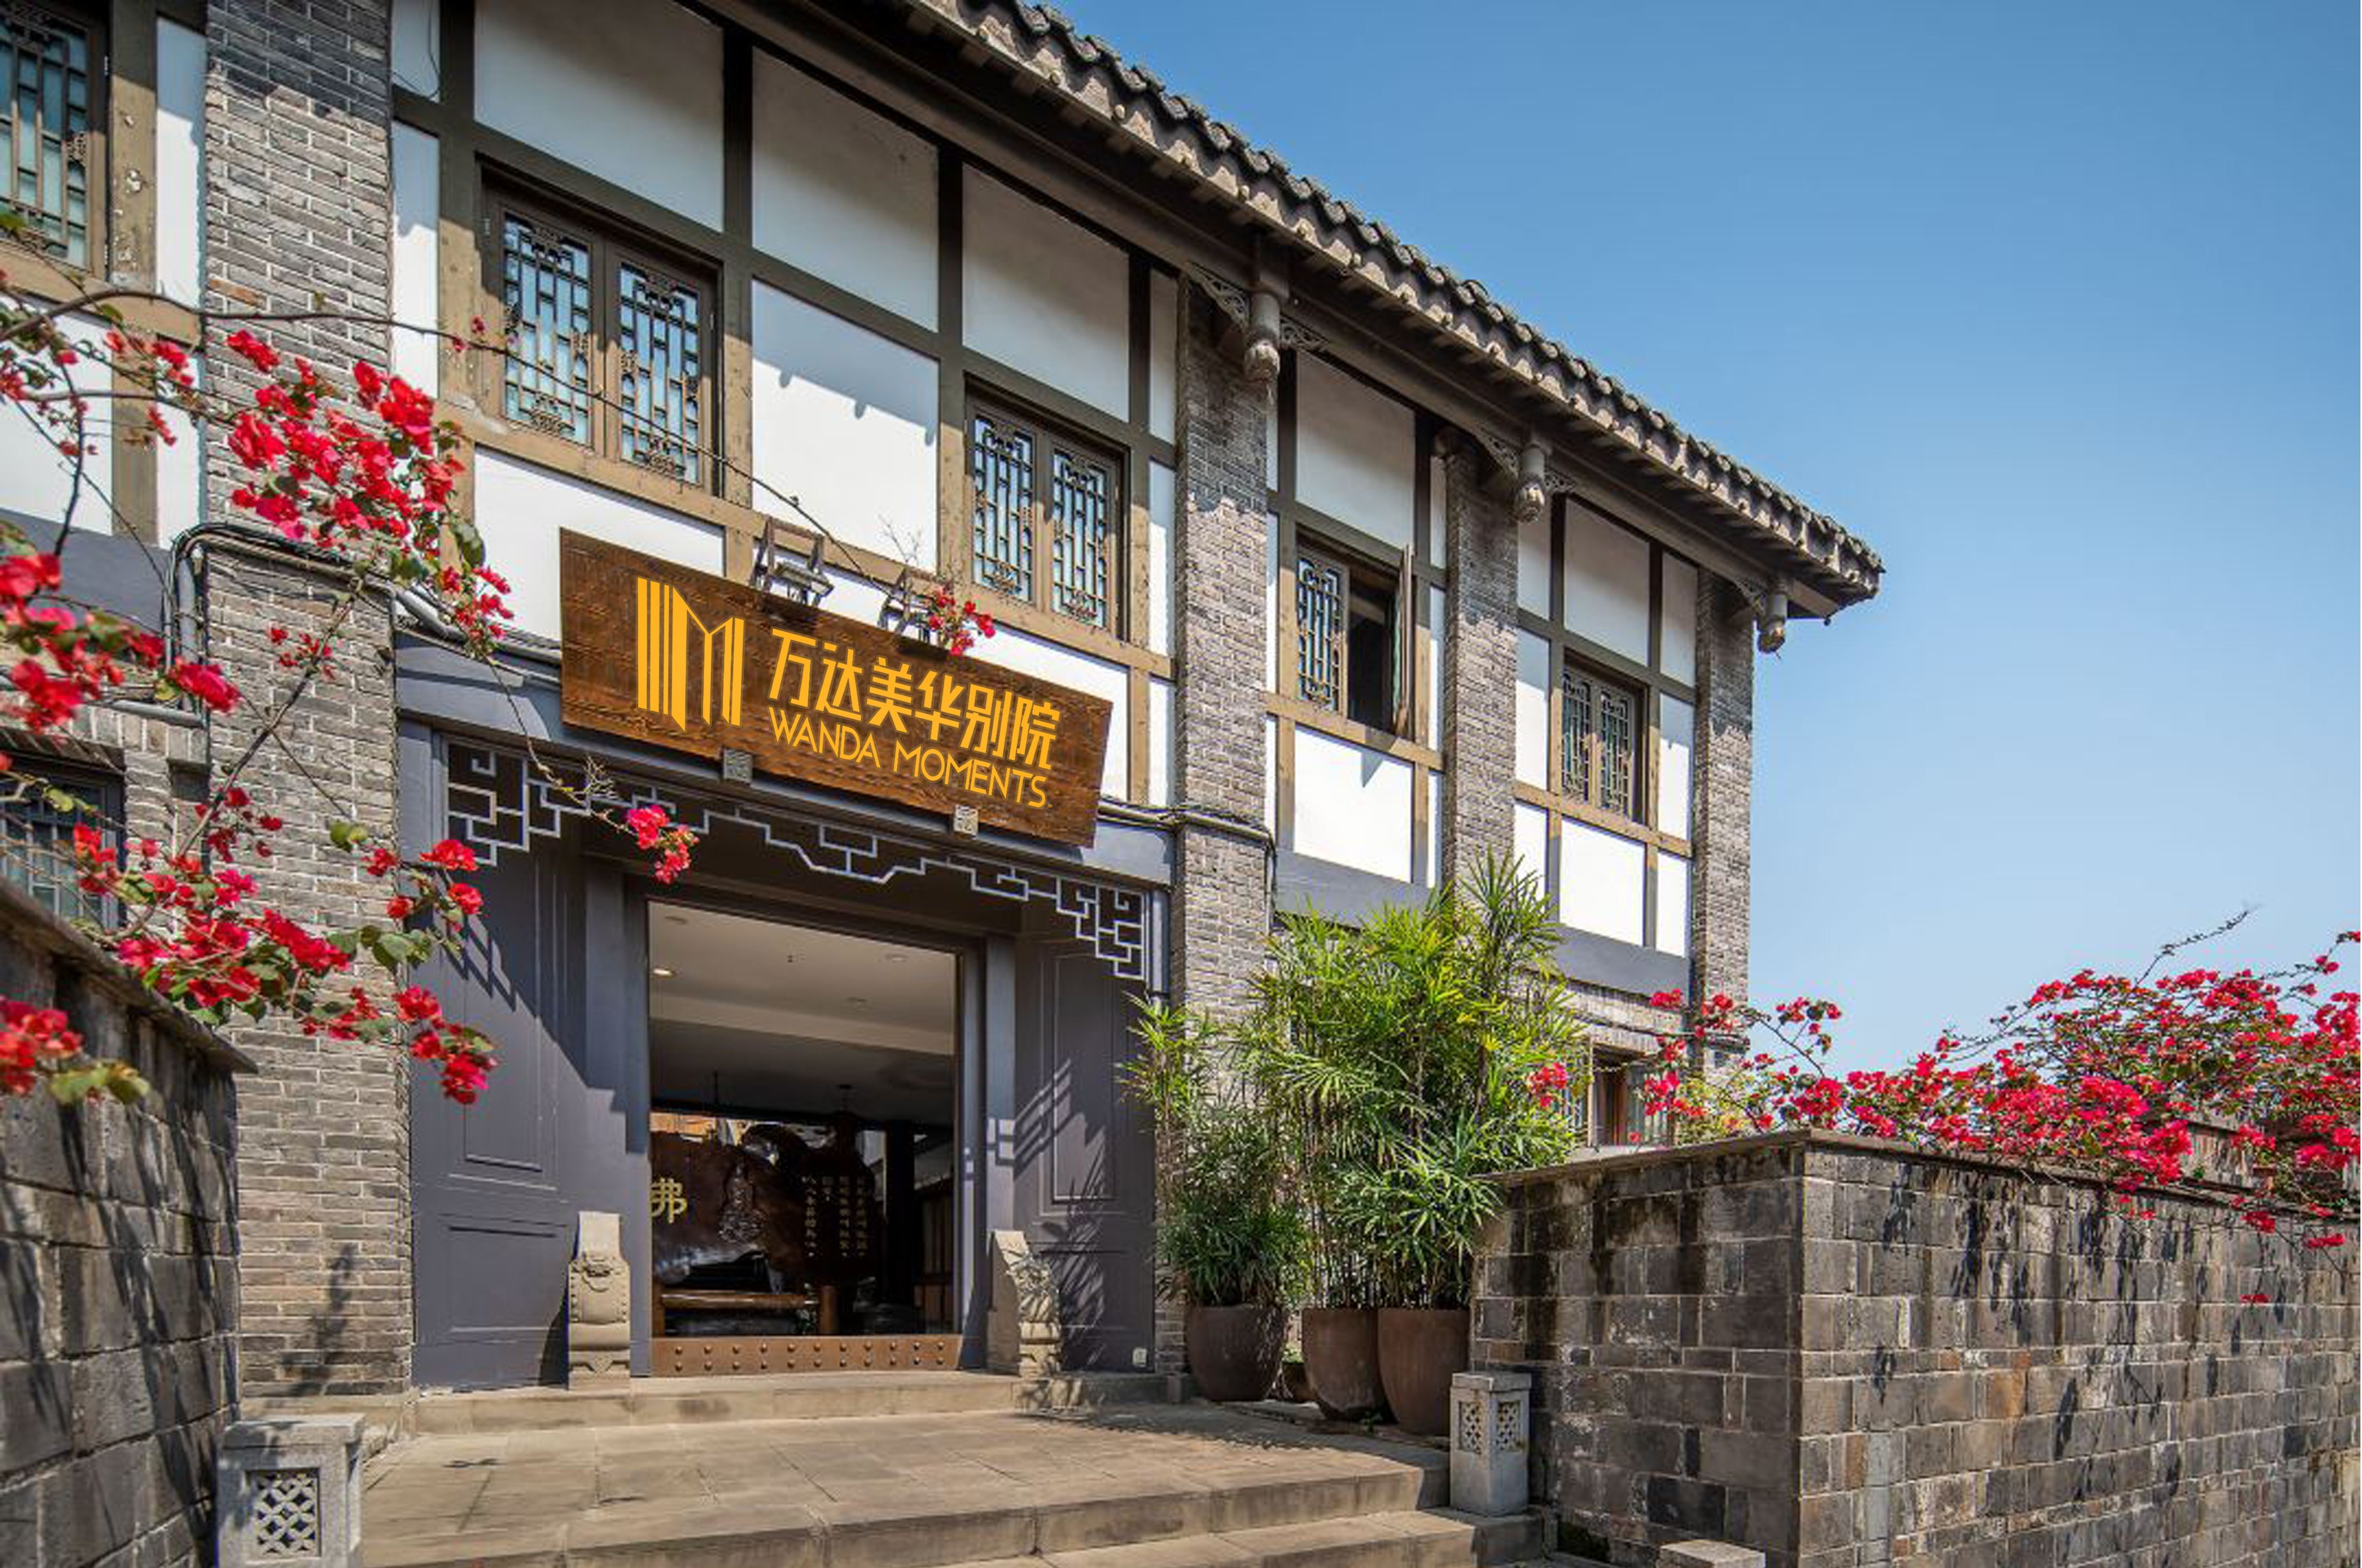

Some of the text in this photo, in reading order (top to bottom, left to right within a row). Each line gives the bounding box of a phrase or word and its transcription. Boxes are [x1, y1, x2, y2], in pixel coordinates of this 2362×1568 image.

[769, 707, 1047, 808] WANDA MOMENTS
[770, 629, 1060, 770] 万达美华别院
